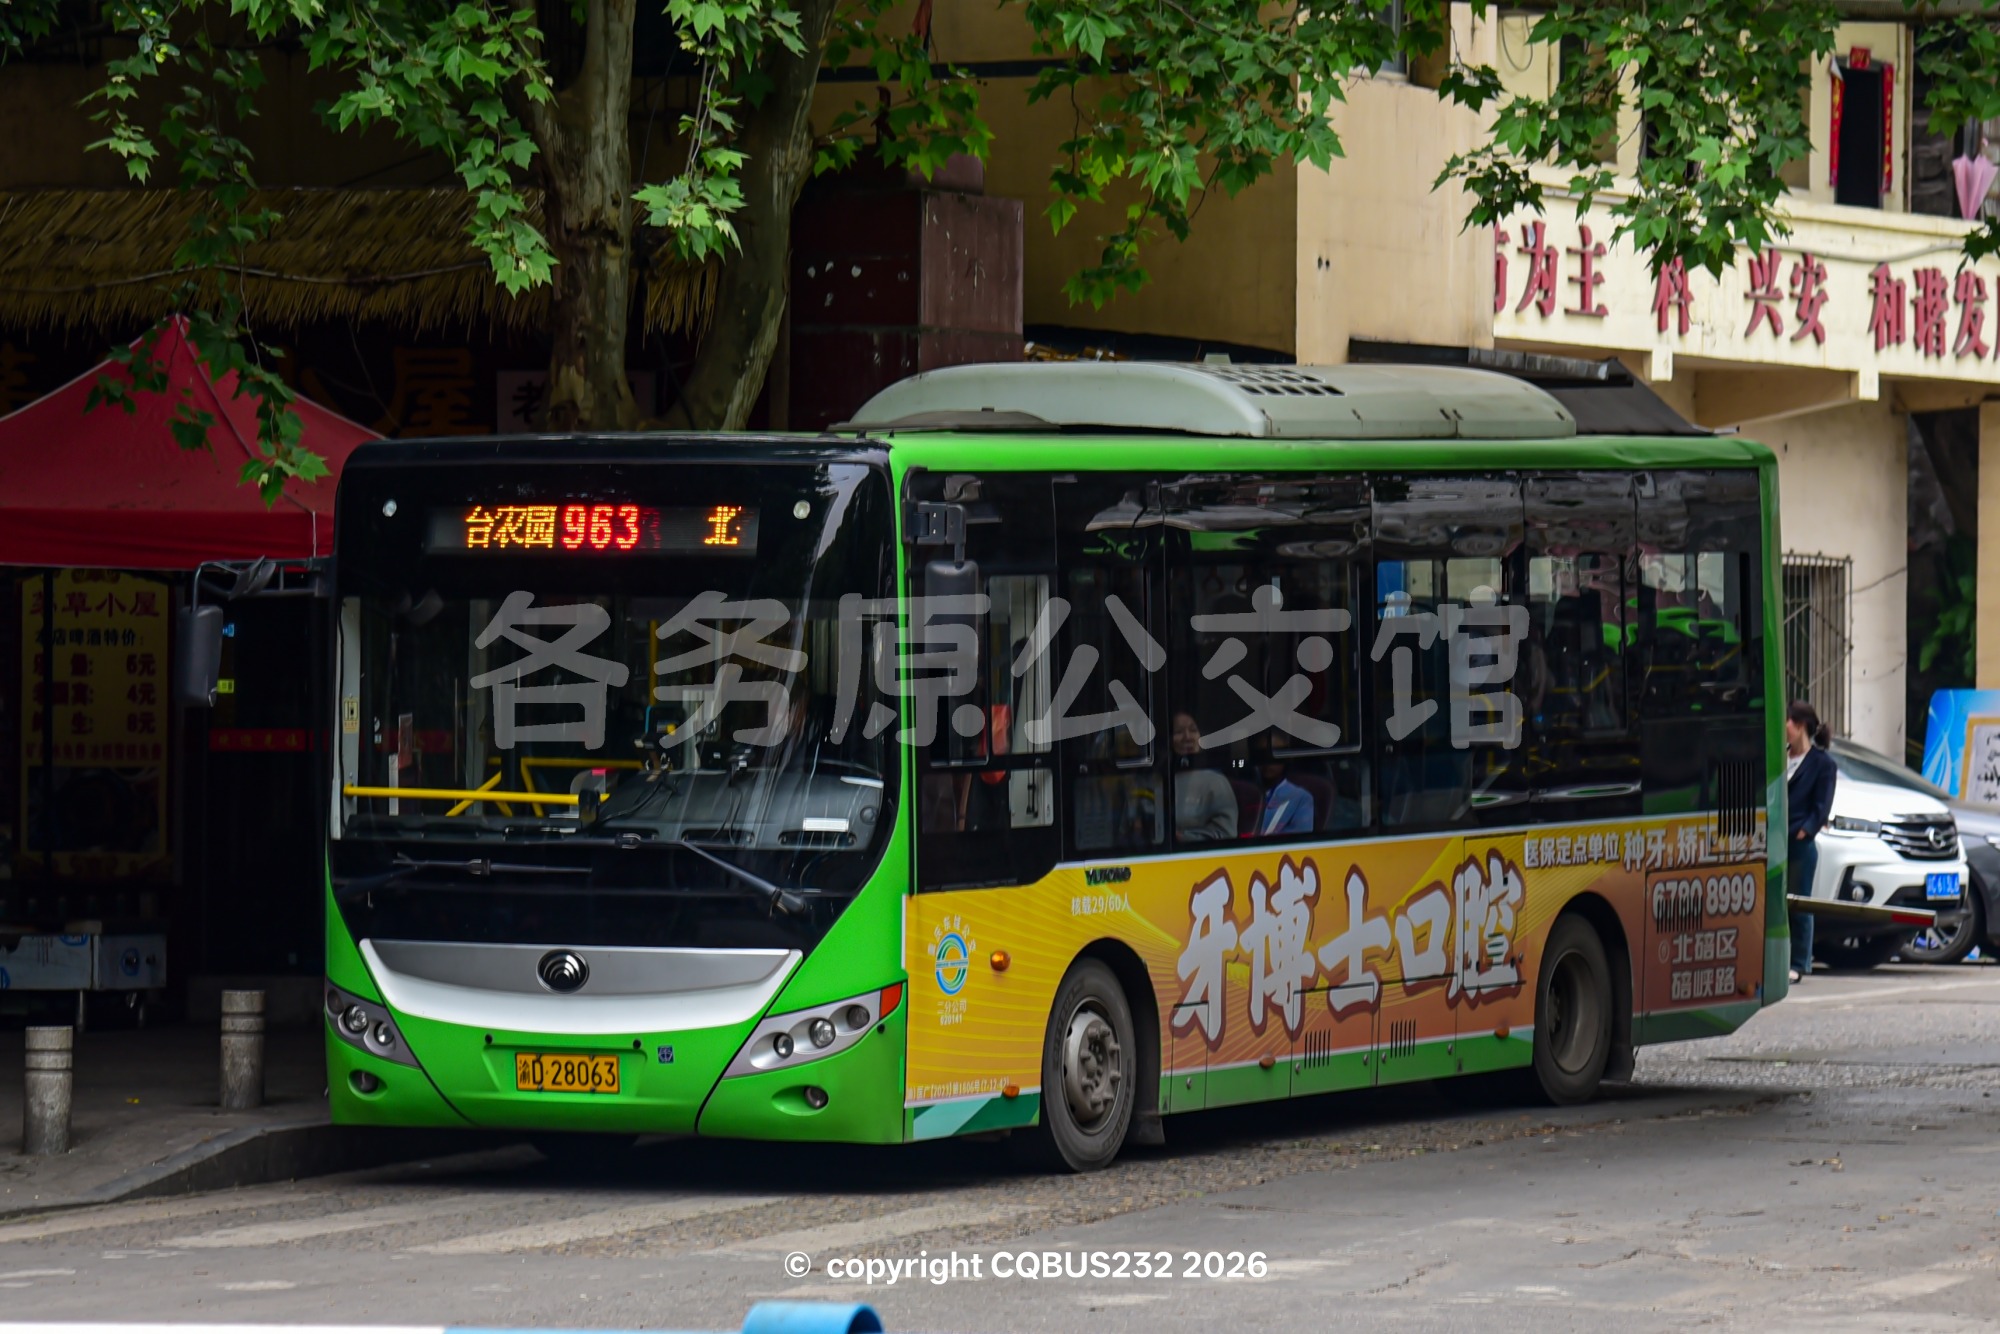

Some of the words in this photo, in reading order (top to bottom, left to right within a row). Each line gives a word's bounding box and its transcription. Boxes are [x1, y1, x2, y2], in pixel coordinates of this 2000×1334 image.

[1868, 262, 2000, 360] 和谐发
[466, 506, 557, 549] 台农园
[562, 505, 641, 549] 963
[1524, 832, 1620, 868] 医保定点单位
[1706, 874, 1755, 916] 8999
[1171, 850, 1525, 1046] 牙博士口腔
[1672, 928, 1738, 964] 北碚区
